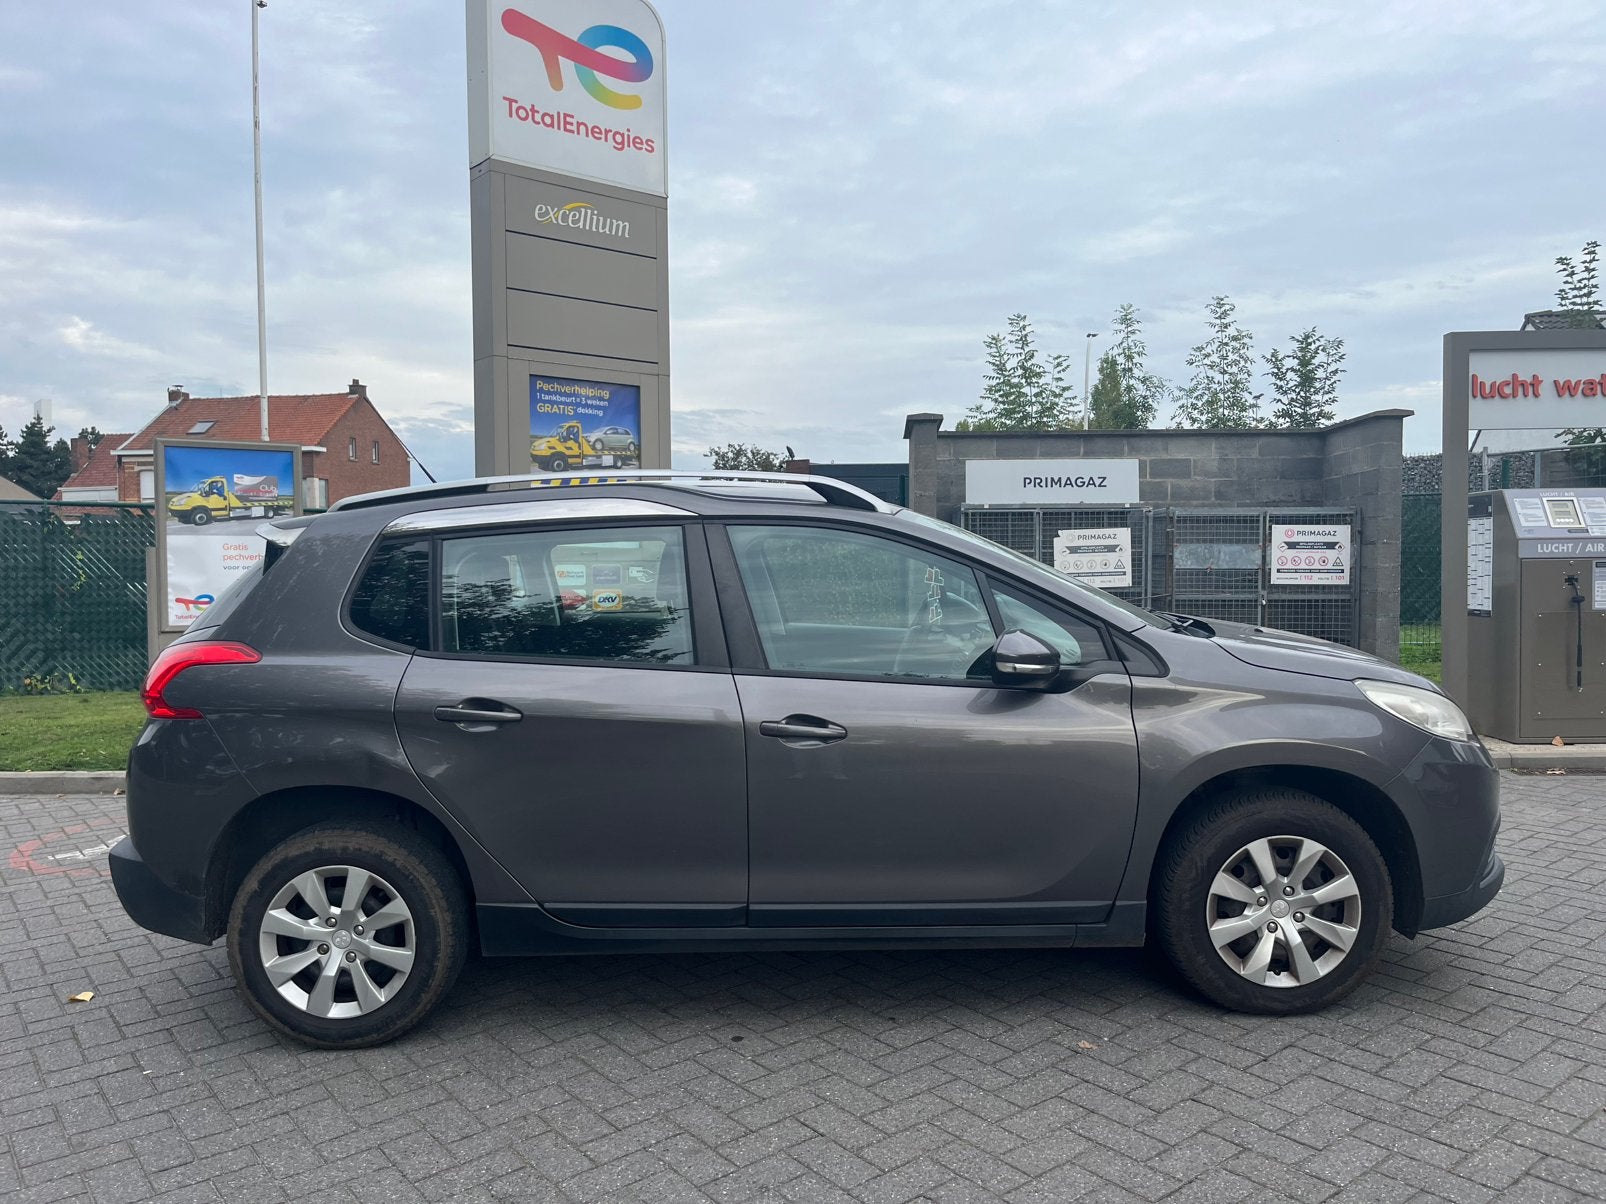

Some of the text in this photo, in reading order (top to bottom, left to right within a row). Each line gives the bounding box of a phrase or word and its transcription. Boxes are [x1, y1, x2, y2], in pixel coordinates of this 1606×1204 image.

[502, 95, 655, 154] TotalEnergies
[534, 203, 630, 238] excellium
[536, 380, 609, 399] Pechverhelping
[1471, 373, 1544, 399] lucht
[542, 393, 576, 403] tankbeurt
[587, 399, 608, 407] weken
[577, 407, 603, 416] dekking
[1023, 476, 1107, 488] PRIMAGAZ
[1077, 533, 1118, 541] PRIMAGAZ
[223, 543, 248, 551] Gratis
[1537, 543, 1574, 553] LUCHT
[1585, 543, 1605, 552] AIR
